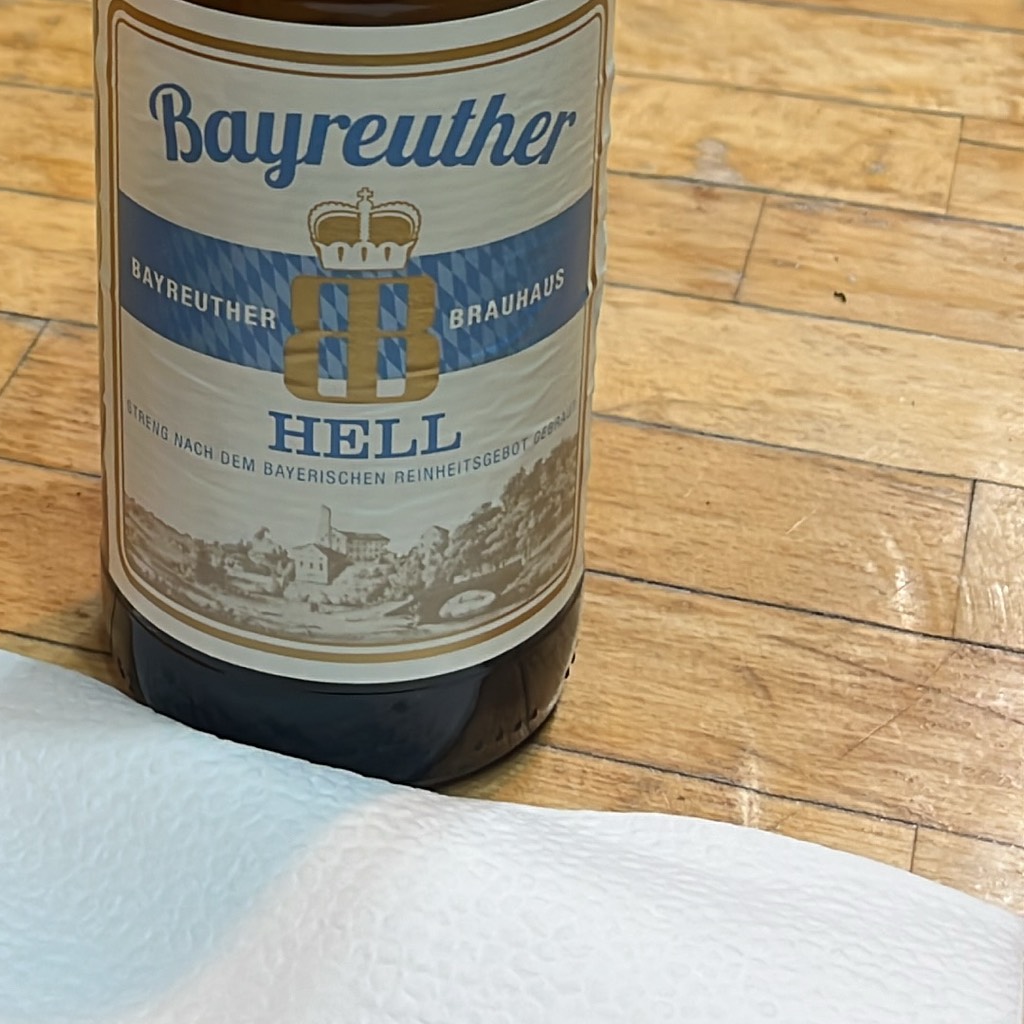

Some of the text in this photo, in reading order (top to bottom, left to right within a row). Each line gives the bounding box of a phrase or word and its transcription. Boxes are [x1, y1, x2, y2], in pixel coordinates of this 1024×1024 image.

[149, 82, 576, 189] Bayreuther
[131, 256, 565, 330] BAYREUTHER BRAUHAUS
[126, 399, 169, 441] STRENG
[174, 432, 214, 461] NACH
[220, 450, 255, 473] DEM
[263, 462, 386, 486] BAYERISCHEN
[394, 437, 528, 486] REINHEITSGEBOT
[268, 410, 462, 460] HELL
